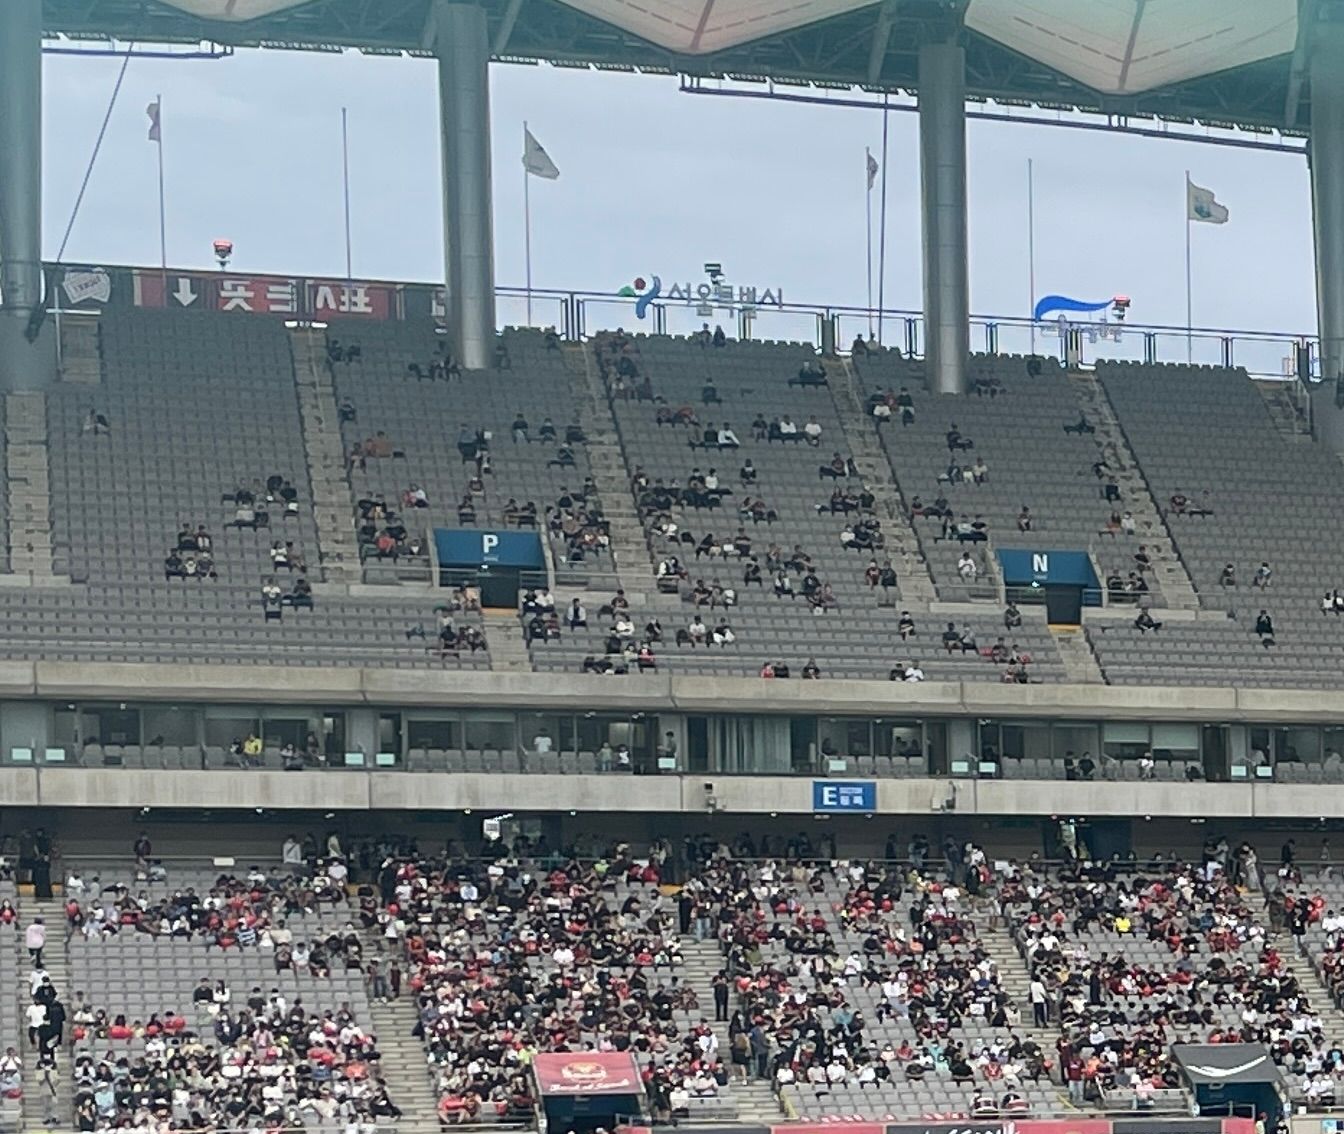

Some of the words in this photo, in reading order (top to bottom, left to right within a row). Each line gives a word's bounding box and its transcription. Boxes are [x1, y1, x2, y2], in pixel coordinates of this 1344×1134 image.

[483, 535, 498, 553] P
[1033, 554, 1048, 572] N
[823, 786, 837, 805] E
